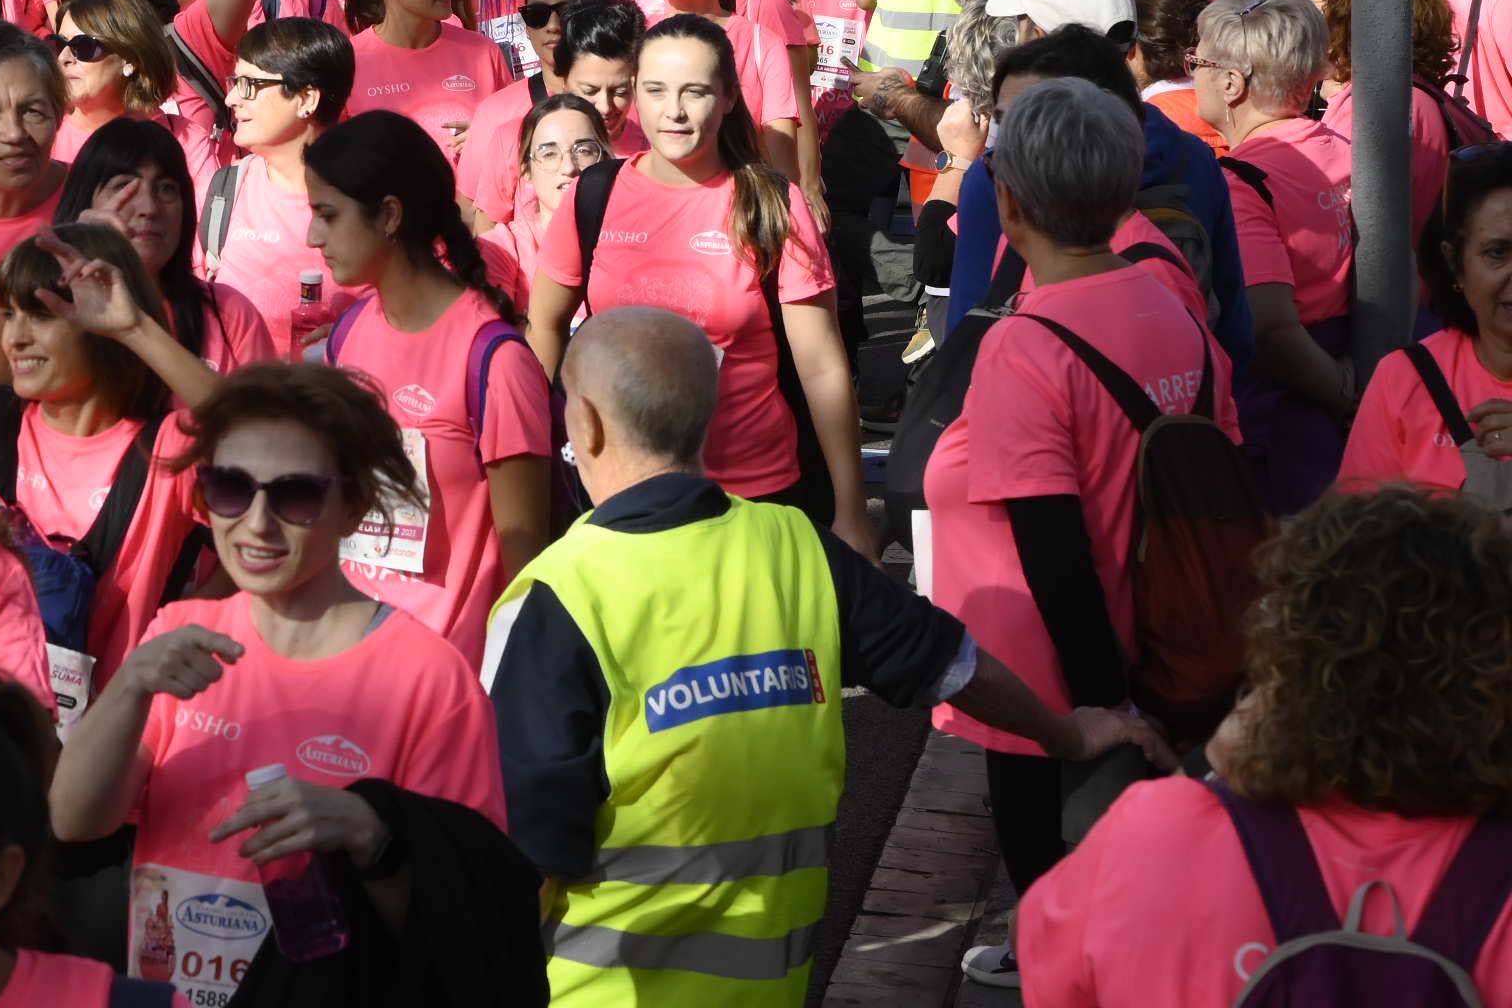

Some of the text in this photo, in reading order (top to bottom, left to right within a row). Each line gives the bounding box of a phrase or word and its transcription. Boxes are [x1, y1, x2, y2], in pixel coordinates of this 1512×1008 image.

[818, 44, 835, 56] 16
[367, 82, 410, 97] OYSHO
[598, 231, 649, 244] OYSHO
[1145, 370, 1203, 407] ARRE
[50, 669, 83, 687] SUMA
[647, 664, 809, 716] VOLUNTARIS
[175, 707, 242, 741] OSHO
[303, 745, 365, 774] ASTURIANA
[182, 905, 260, 933] ASTURIANA
